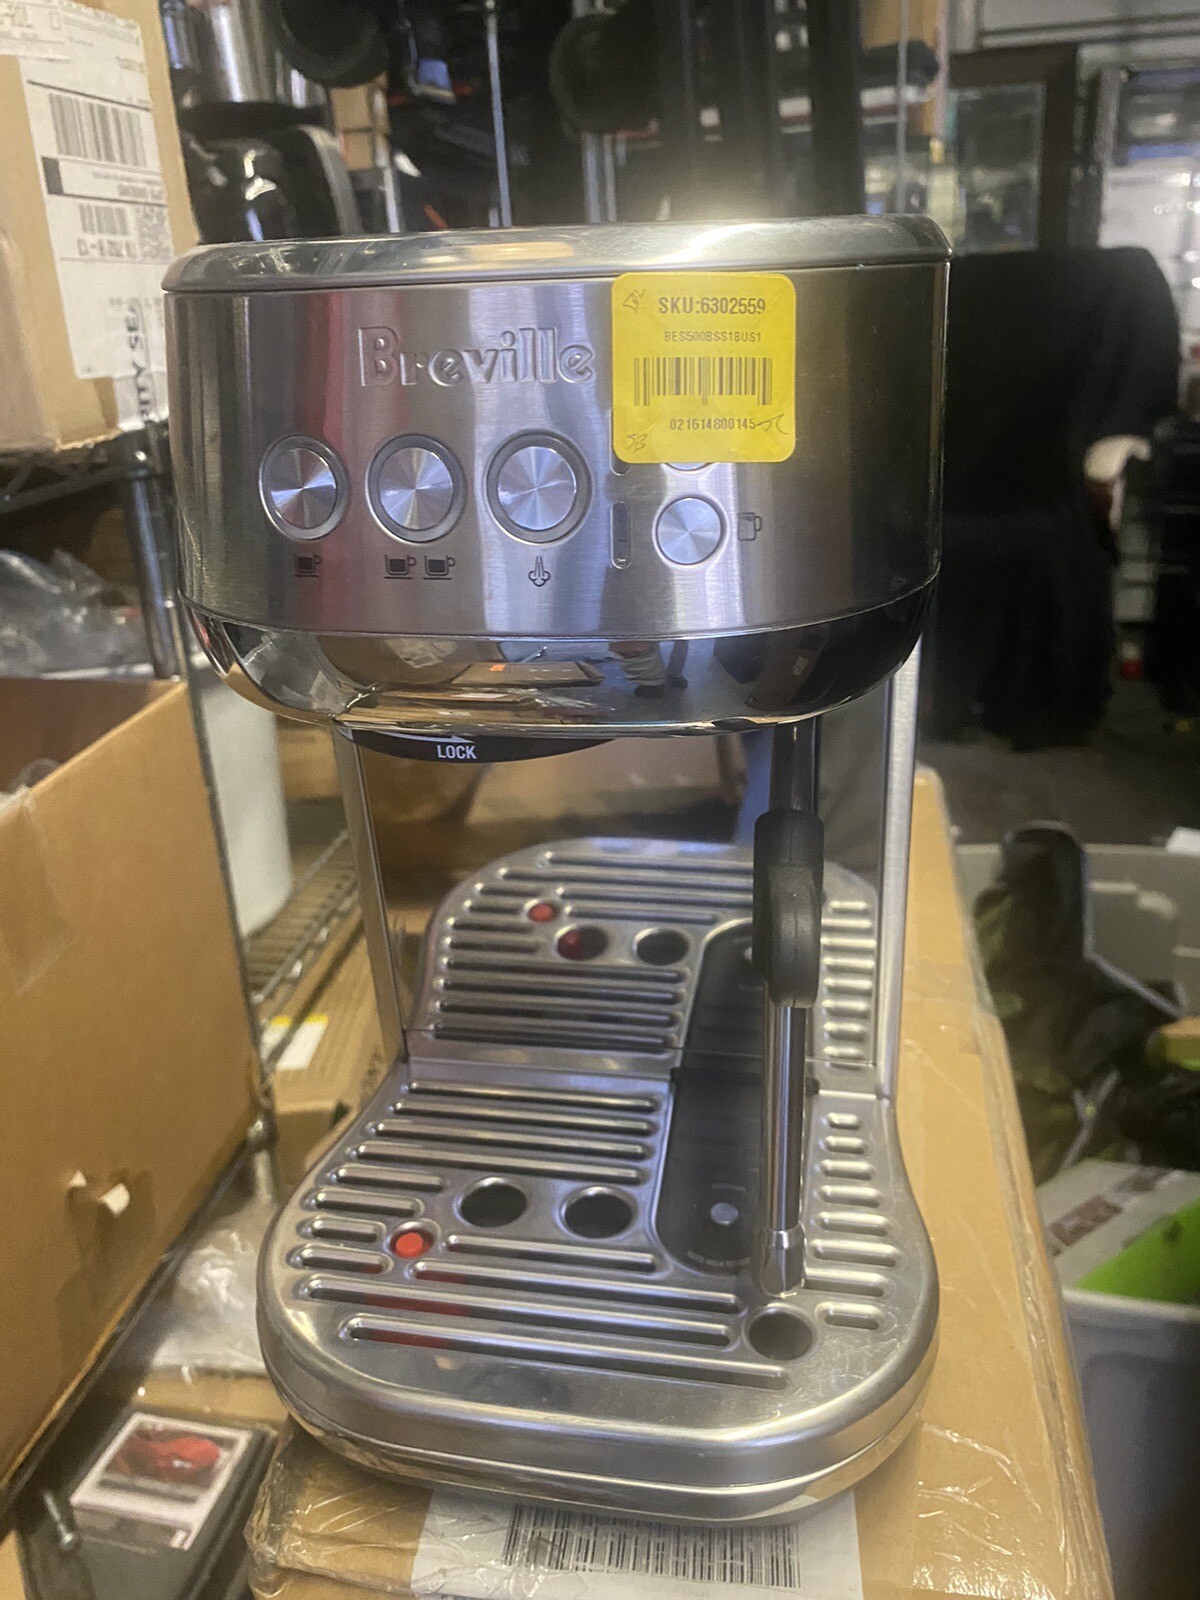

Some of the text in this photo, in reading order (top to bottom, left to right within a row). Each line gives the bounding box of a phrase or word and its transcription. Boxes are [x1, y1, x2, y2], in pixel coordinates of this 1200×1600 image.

[658, 297, 766, 315] SKU:6302559
[663, 331, 762, 343] BES500BSS1BUS1
[358, 326, 595, 387] Breville
[669, 418, 756, 431] 021614800145
[437, 745, 477, 759] LOCK
